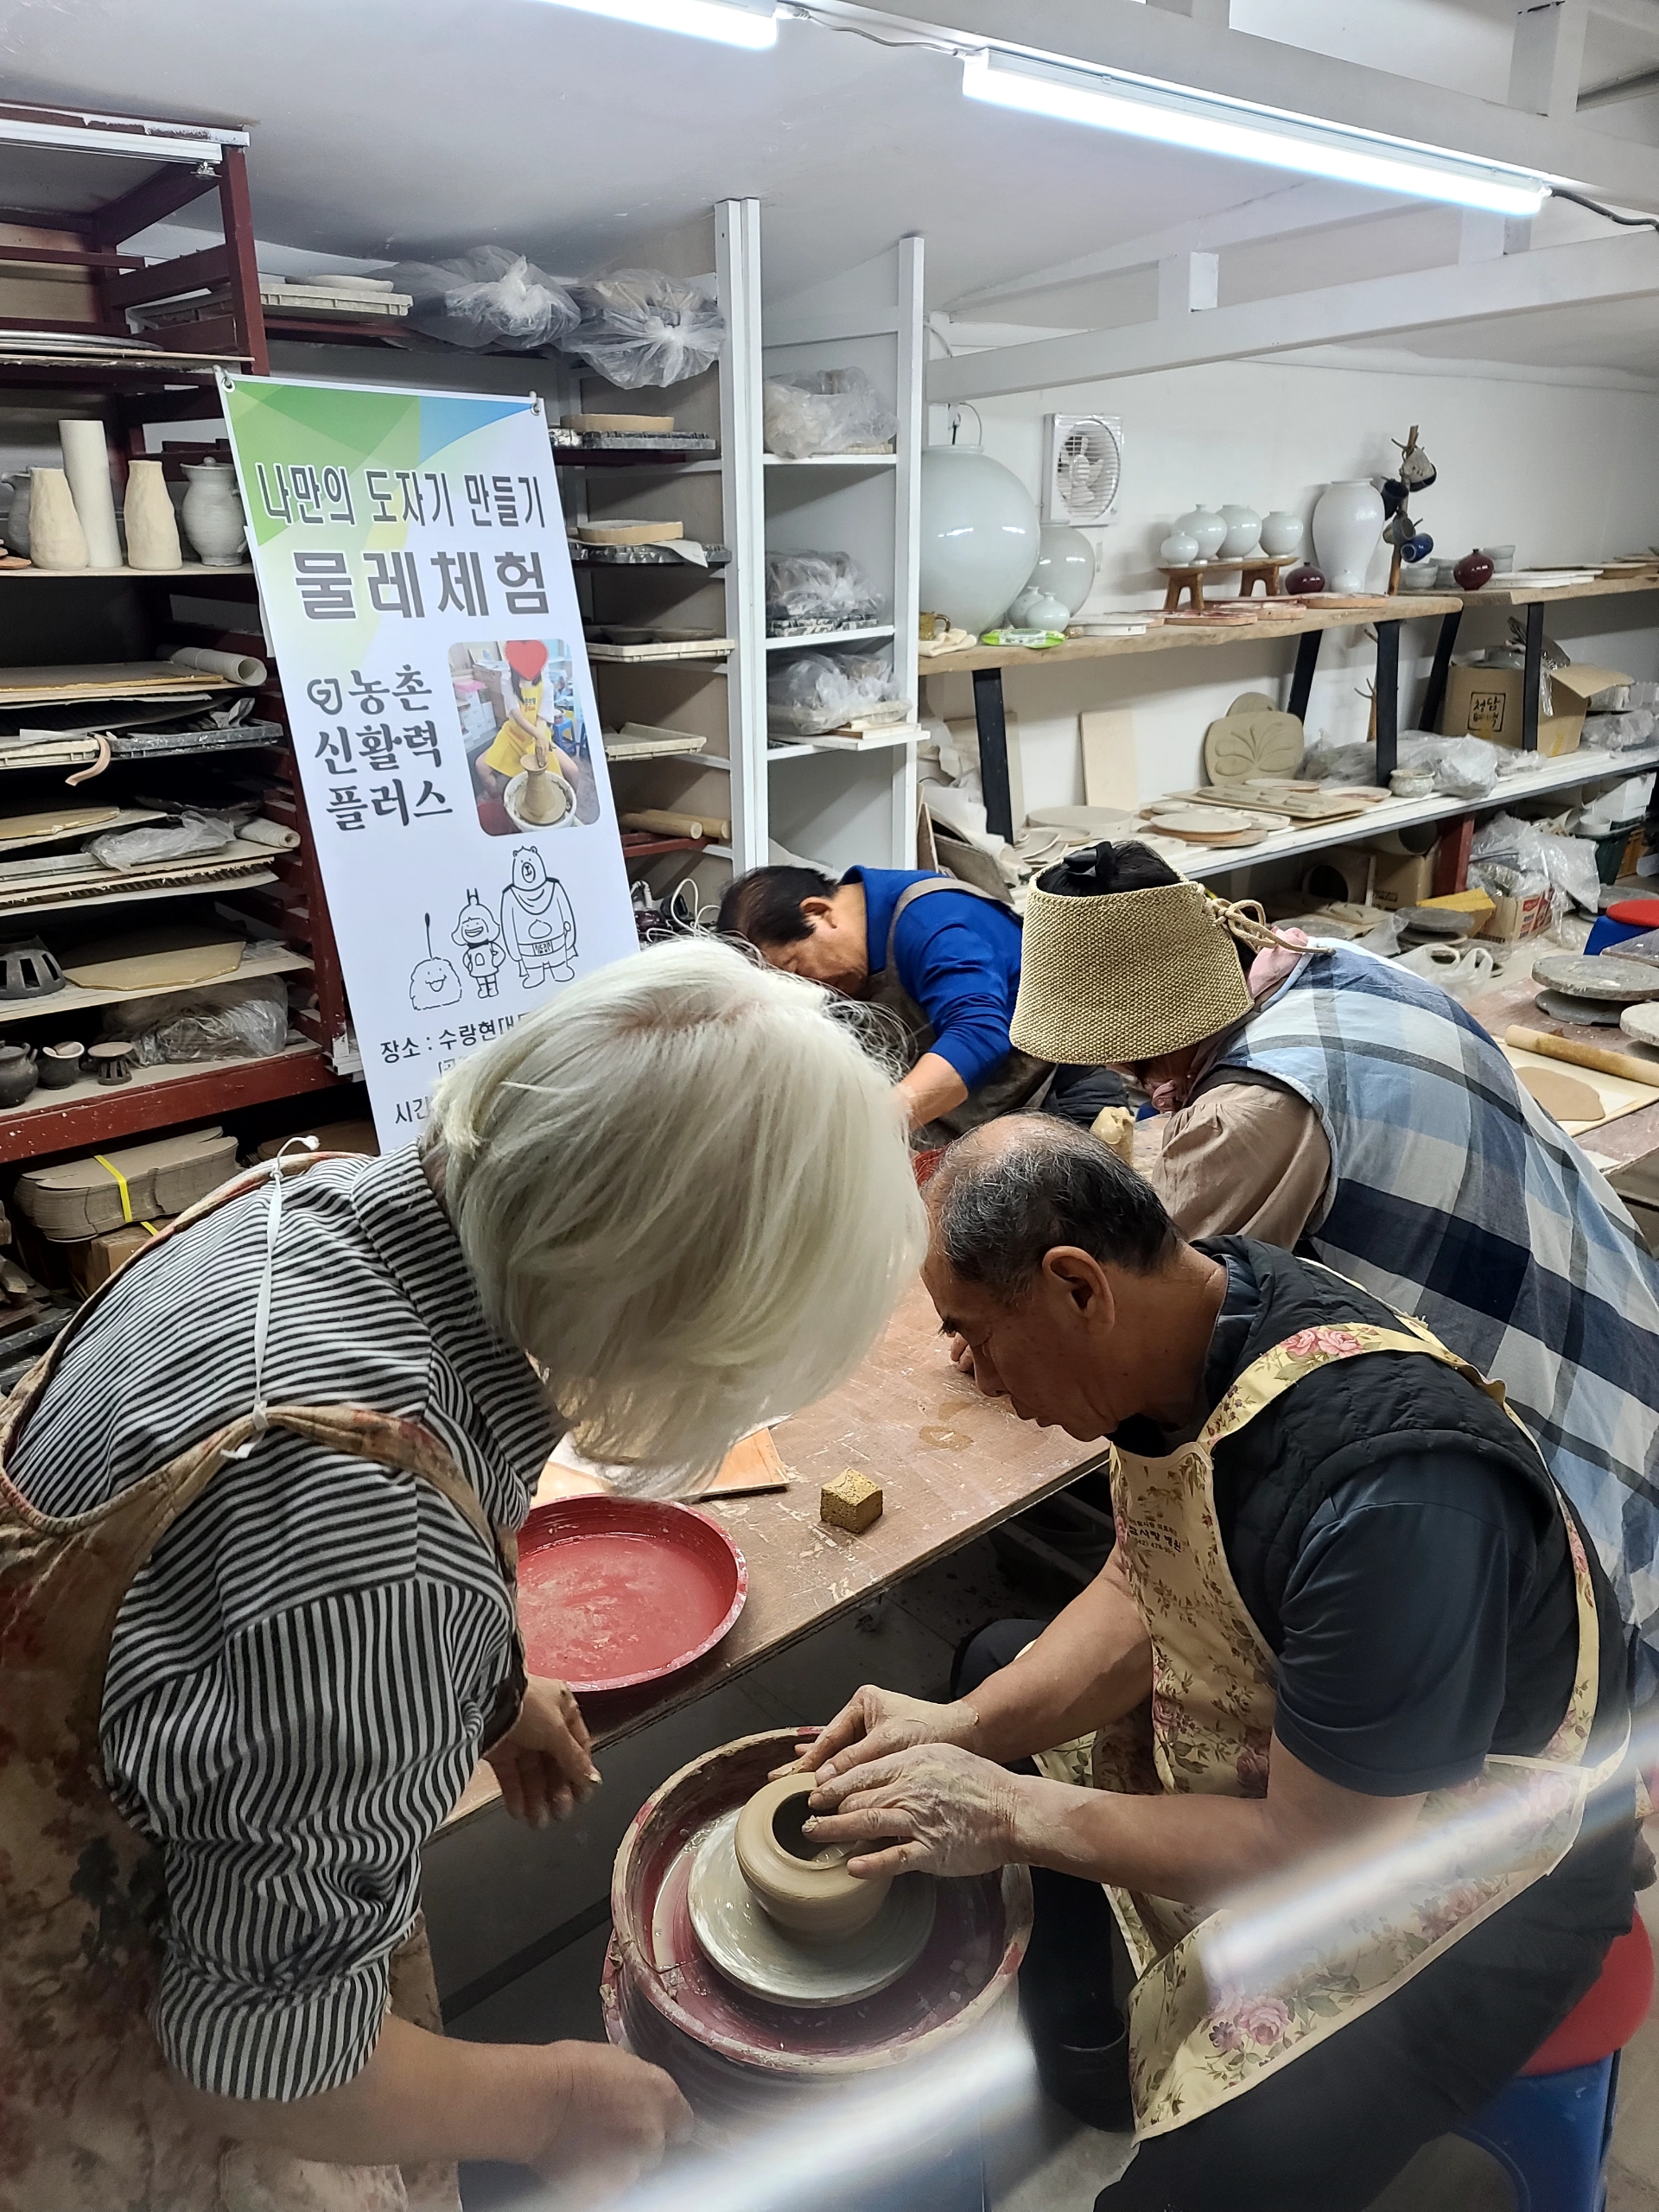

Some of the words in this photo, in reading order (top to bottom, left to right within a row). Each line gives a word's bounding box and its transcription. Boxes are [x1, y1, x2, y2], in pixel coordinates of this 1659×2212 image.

[257, 464, 354, 525] 나만의
[366, 471, 454, 527] 도자기
[465, 474, 545, 528] 만들기
[294, 551, 550, 620] 물레체험
[348, 664, 432, 715] 농촌
[1473, 696, 1501, 712] 청담
[315, 721, 442, 775] 신활력
[326, 779, 454, 831] 플러스
[380, 1037, 421, 1064] 장소
[438, 1012, 531, 1051] 수랑현대
